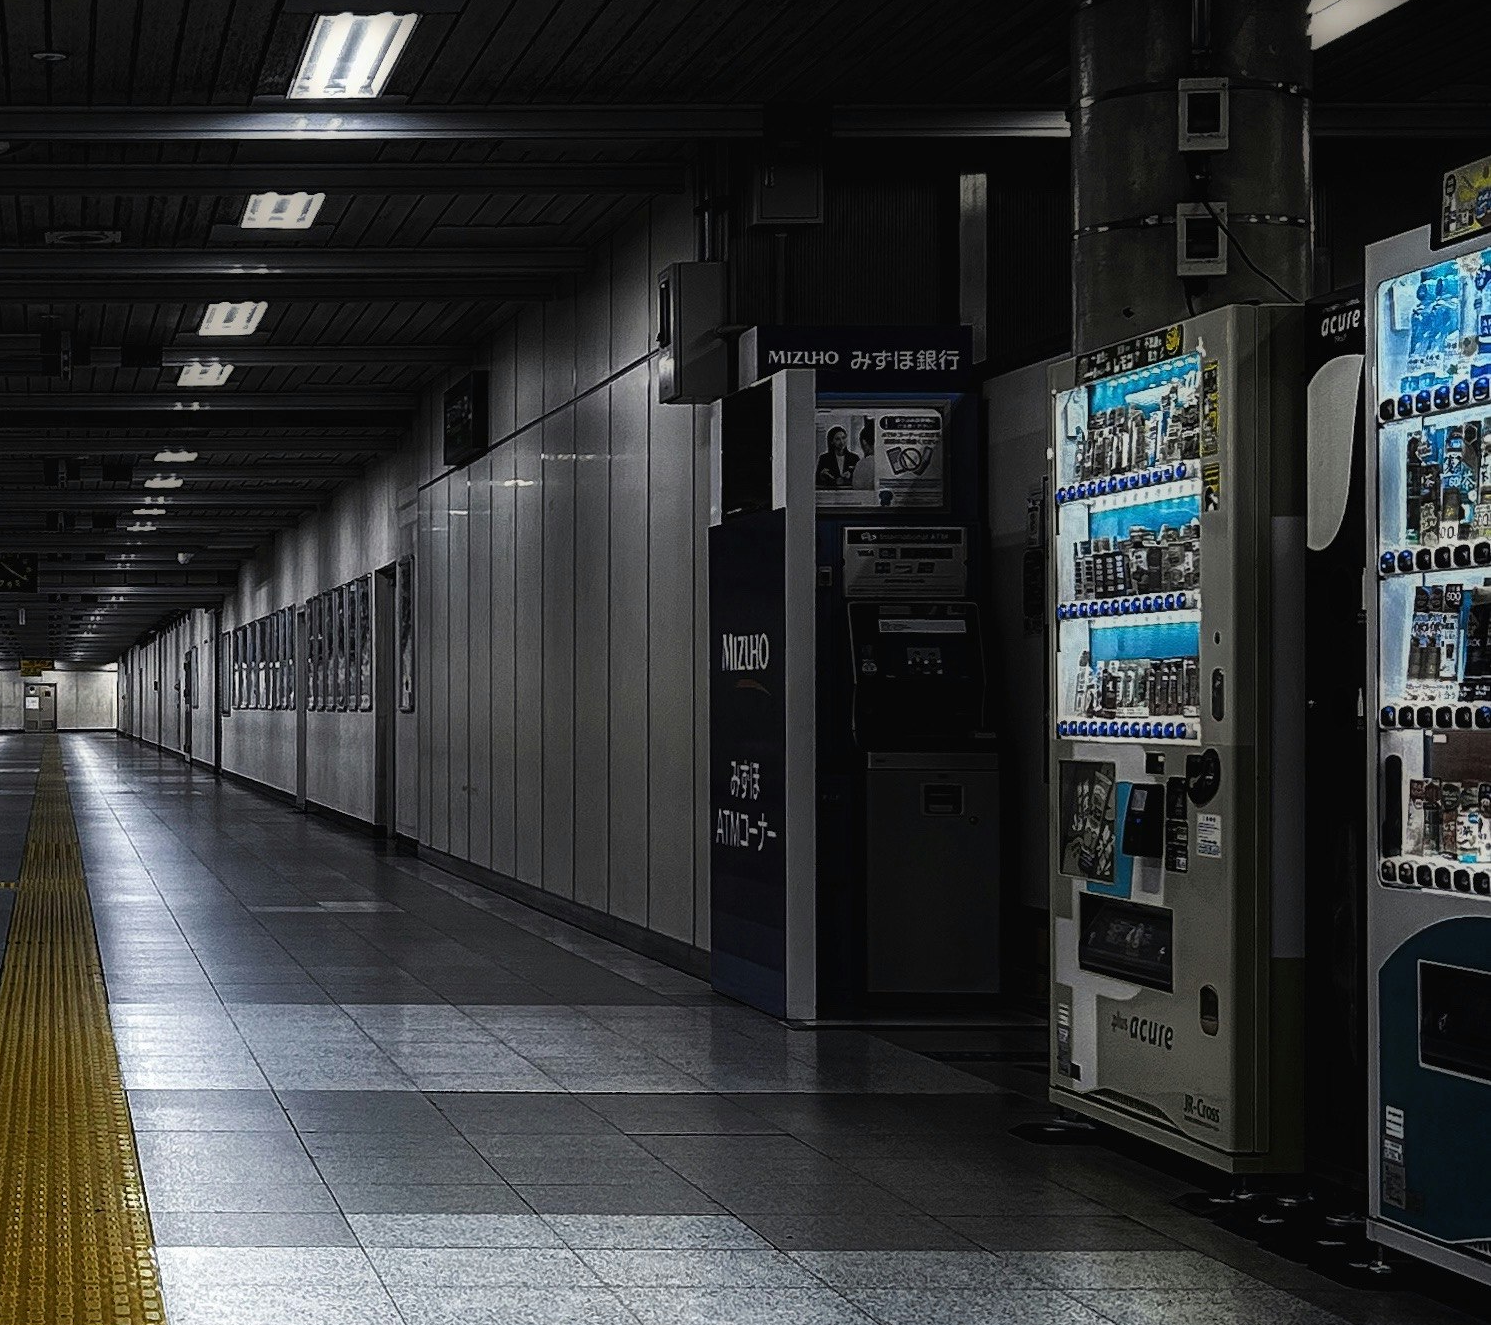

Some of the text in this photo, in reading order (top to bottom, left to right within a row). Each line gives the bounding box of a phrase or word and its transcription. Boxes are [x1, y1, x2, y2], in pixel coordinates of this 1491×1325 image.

[767, 349, 960, 371] MIZUHO みずほ銀行
[721, 633, 770, 671] MIZUHO
[731, 759, 760, 801] みずほ
[716, 808, 777, 852] ATMコーナー
[1130, 1016, 1173, 1050] acure
